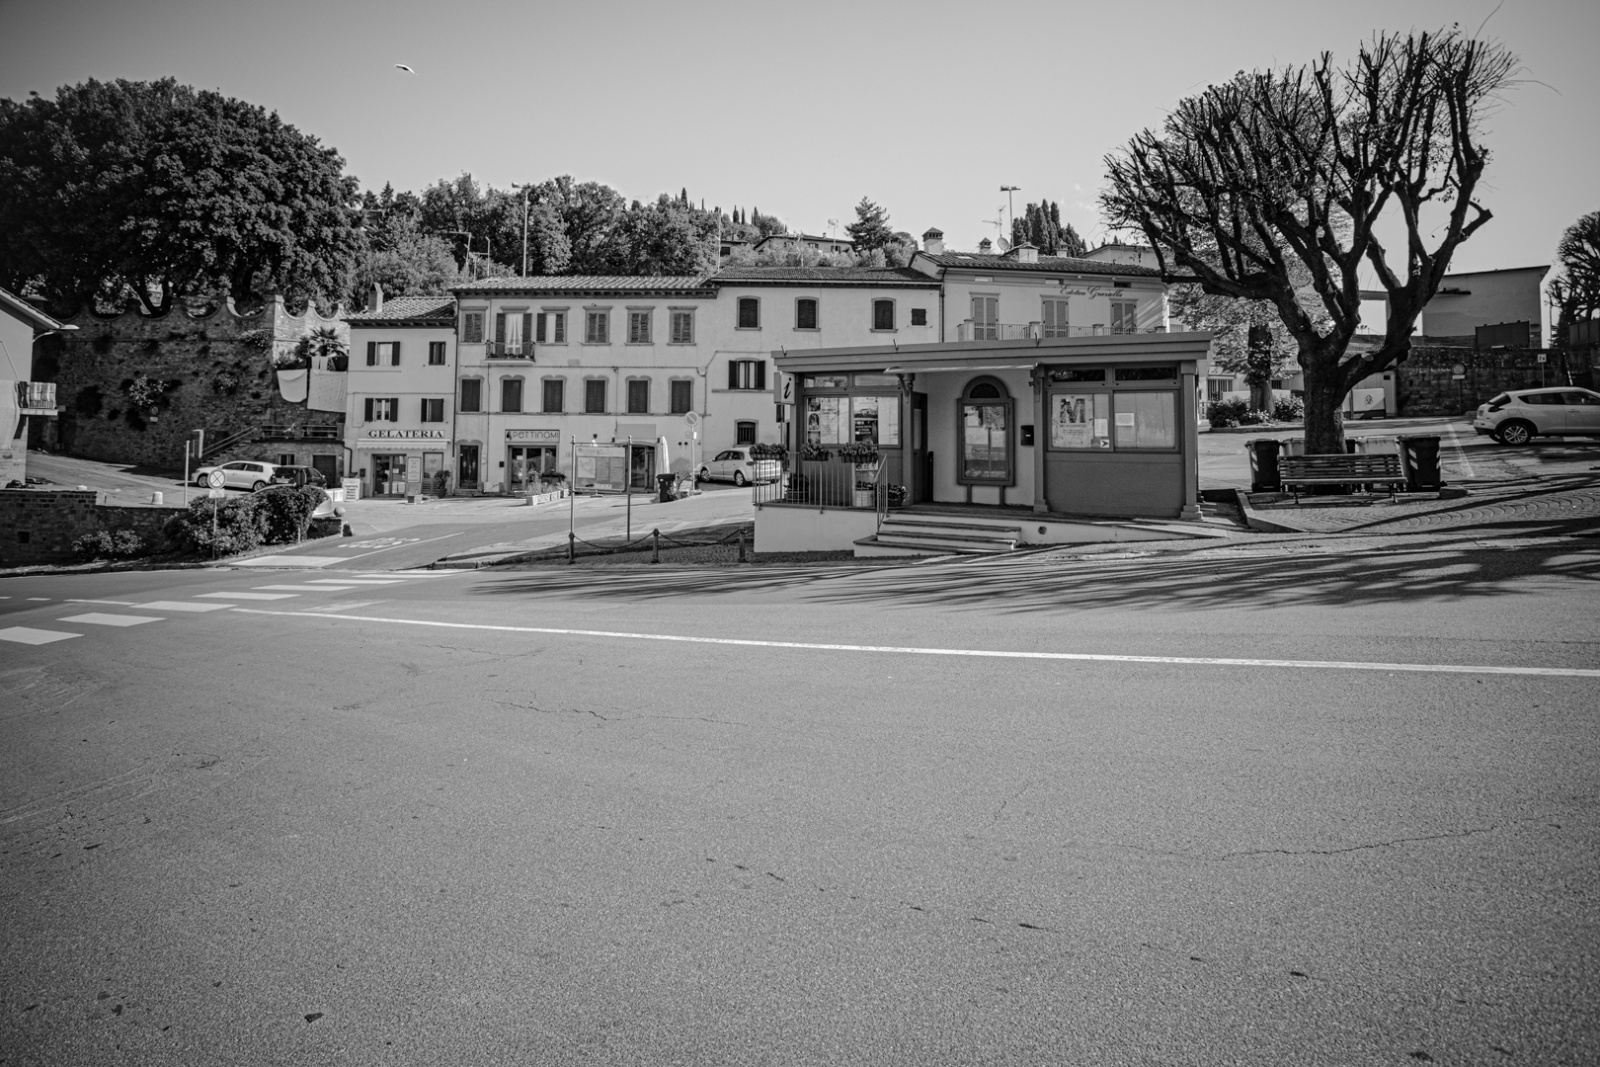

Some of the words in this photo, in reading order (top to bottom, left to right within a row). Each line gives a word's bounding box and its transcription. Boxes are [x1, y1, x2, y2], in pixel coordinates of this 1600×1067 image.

[783, 377, 791, 399] i
[1060, 398, 1086, 423] M
[368, 430, 443, 438] GELATERIA
